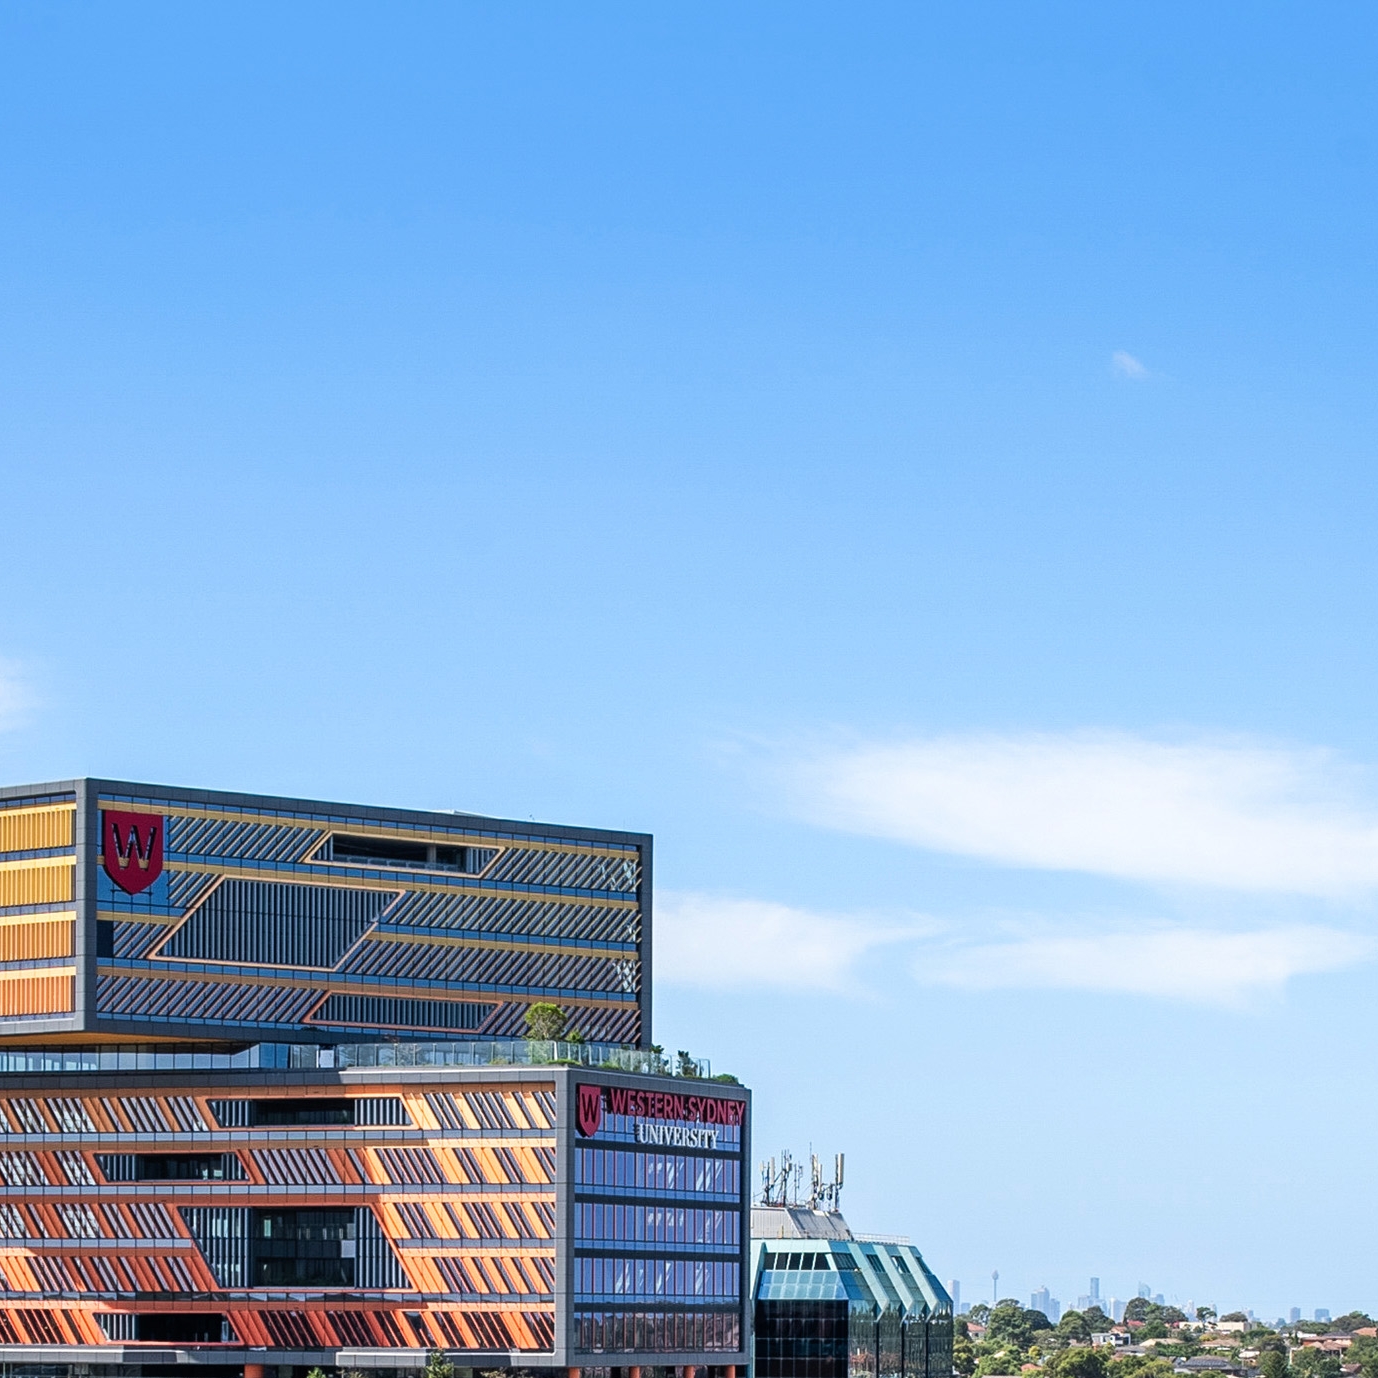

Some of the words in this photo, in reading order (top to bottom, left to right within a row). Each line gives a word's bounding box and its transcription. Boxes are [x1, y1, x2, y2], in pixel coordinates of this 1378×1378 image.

[112, 823, 157, 872] W
[610, 1088, 684, 1120] WESTERN
[688, 1097, 746, 1126] SYDNEY
[638, 1123, 720, 1150] UNIVERSITY
